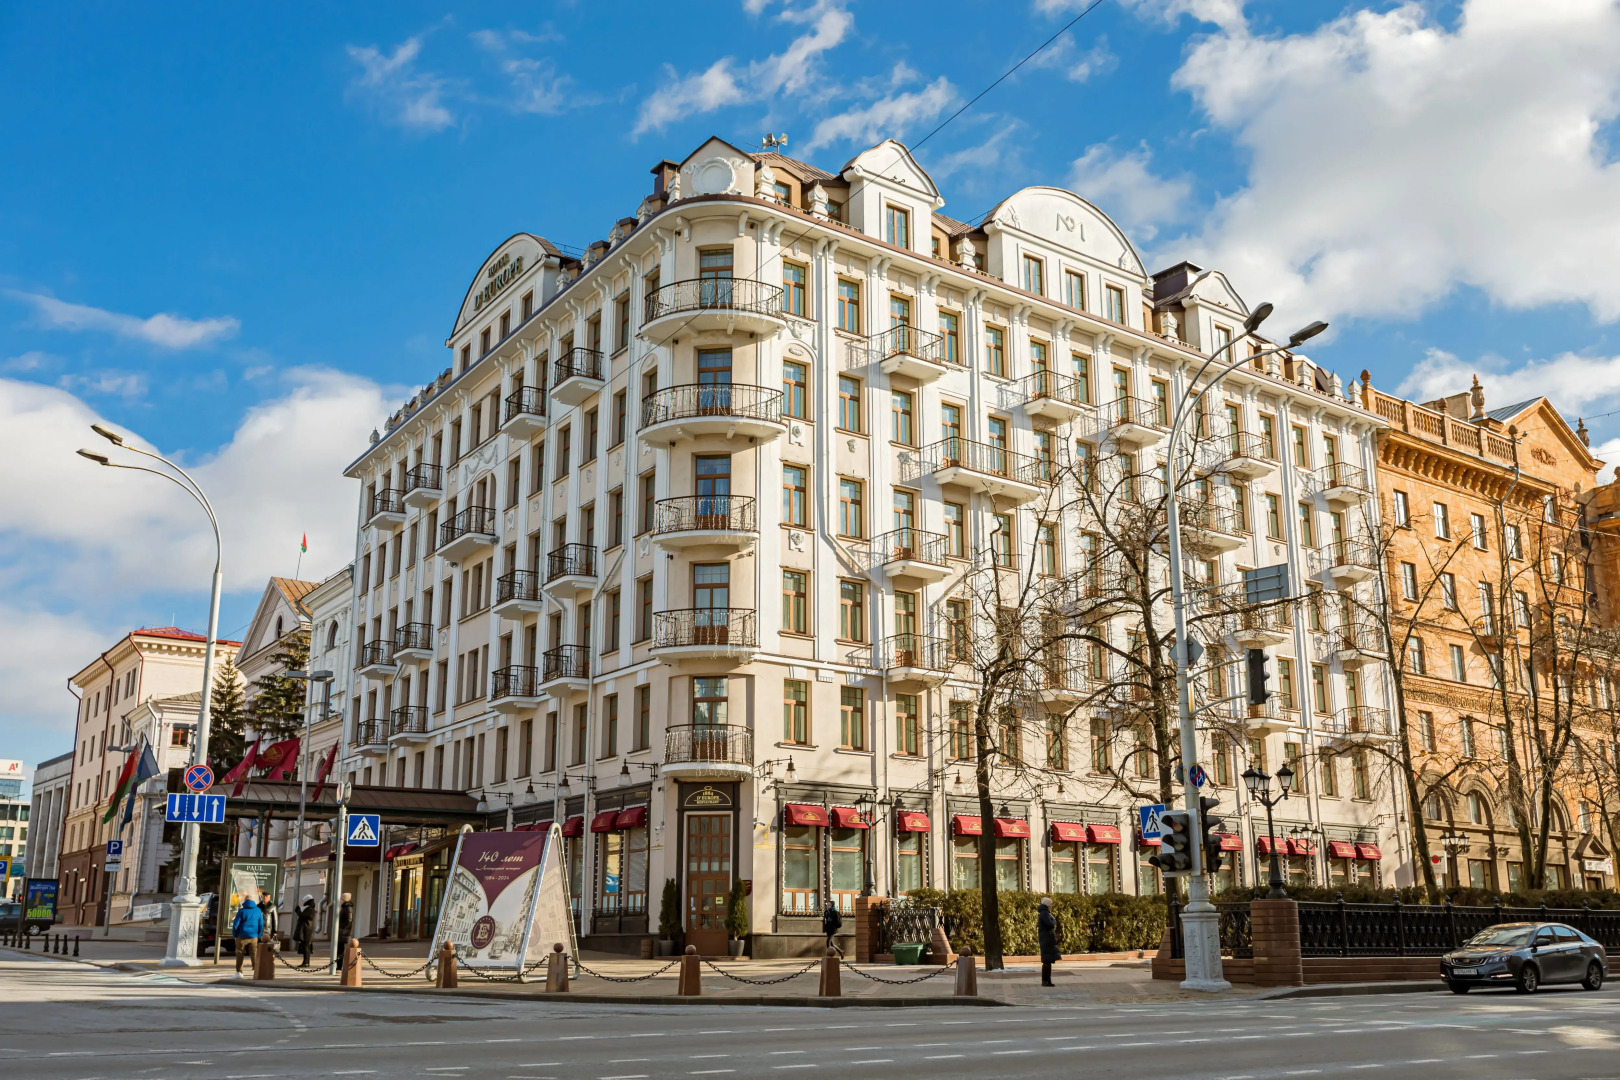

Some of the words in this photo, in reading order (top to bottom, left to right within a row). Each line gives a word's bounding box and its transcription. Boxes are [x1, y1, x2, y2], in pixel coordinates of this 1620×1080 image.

[110, 841, 120, 854] P
[478, 850, 499, 862] 140
[27, 908, 52, 918] 50000
